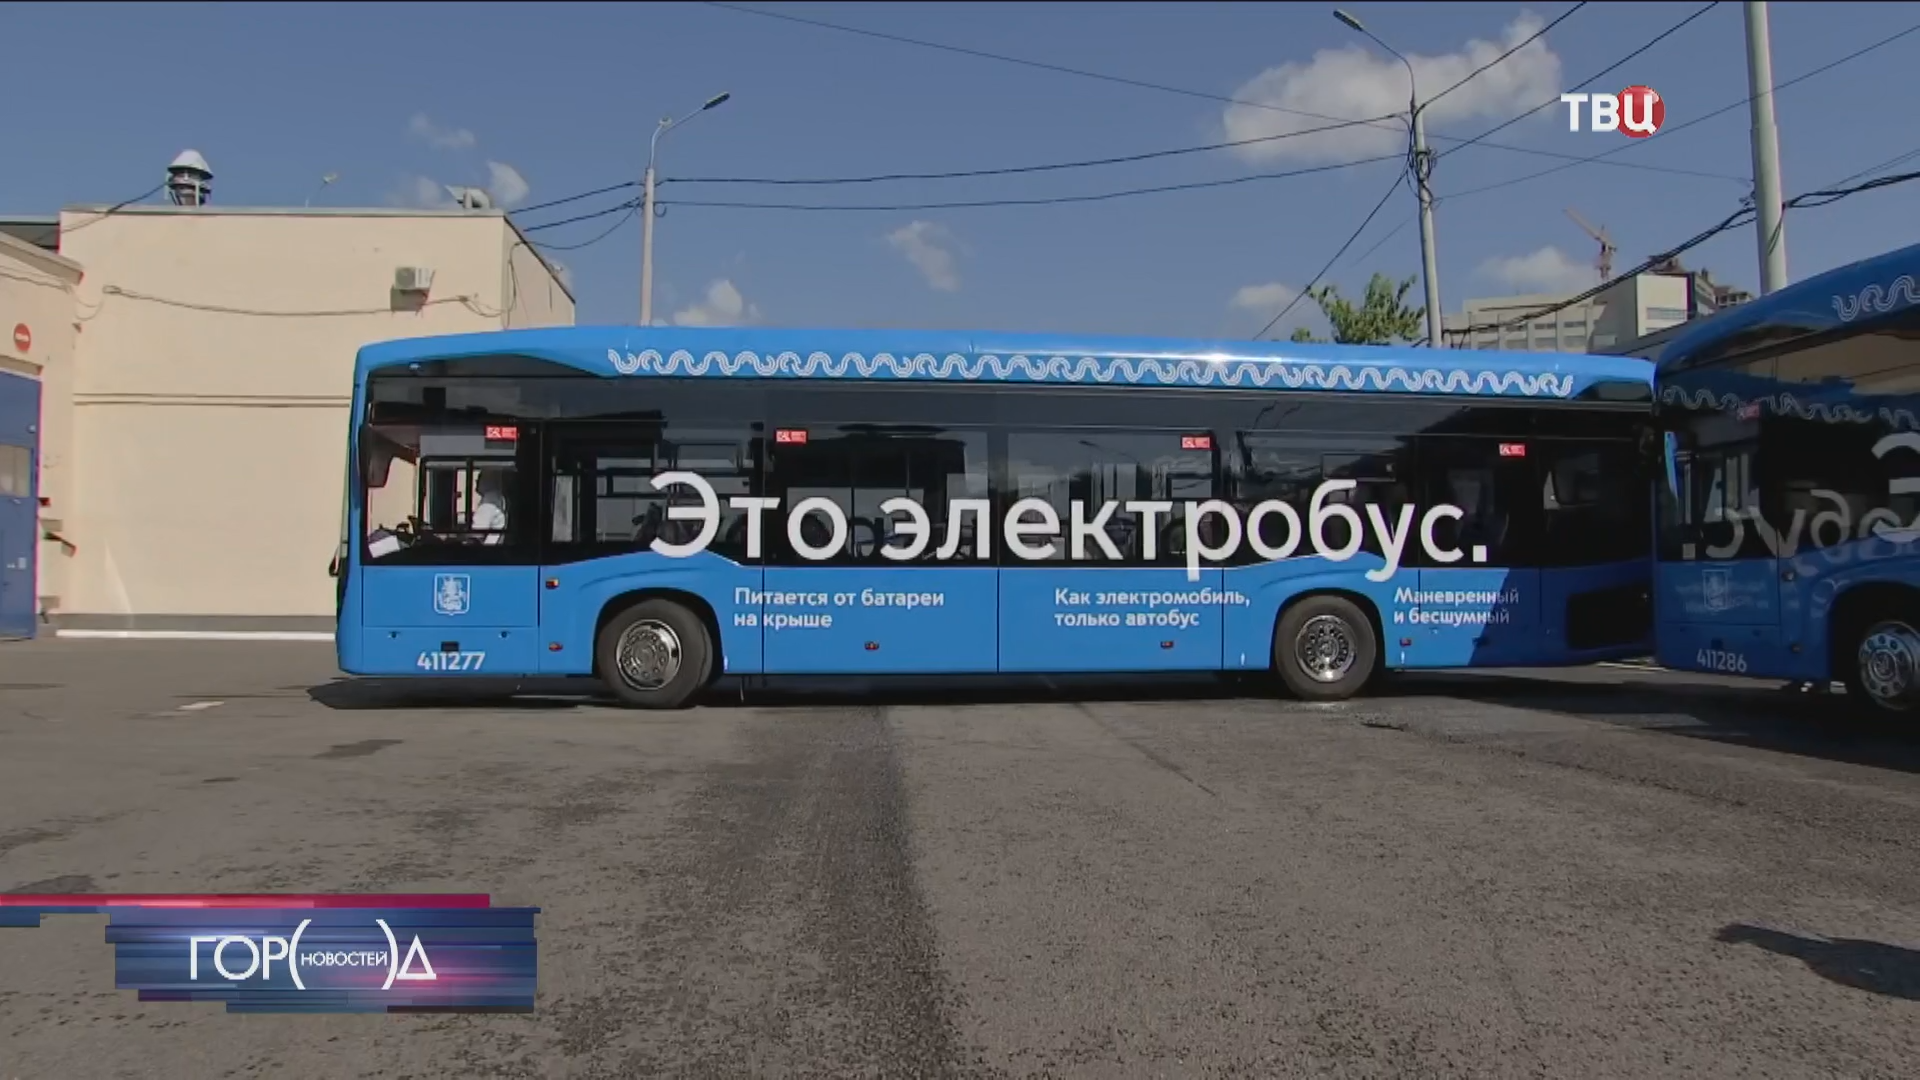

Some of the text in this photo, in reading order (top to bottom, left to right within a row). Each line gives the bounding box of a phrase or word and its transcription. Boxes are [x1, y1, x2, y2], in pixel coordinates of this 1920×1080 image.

[649, 471, 1487, 582] Это электробус.
[734, 587, 944, 609] Питается от батареи
[1055, 587, 1250, 608] Как электромобиль,
[1394, 587, 1519, 606] Маневренный
[734, 613, 833, 630] на крыше
[1054, 609, 1200, 629] только автобус
[1394, 607, 1510, 627] и бесшумный
[416, 651, 486, 671] 411277
[1696, 648, 1748, 673] 411286
